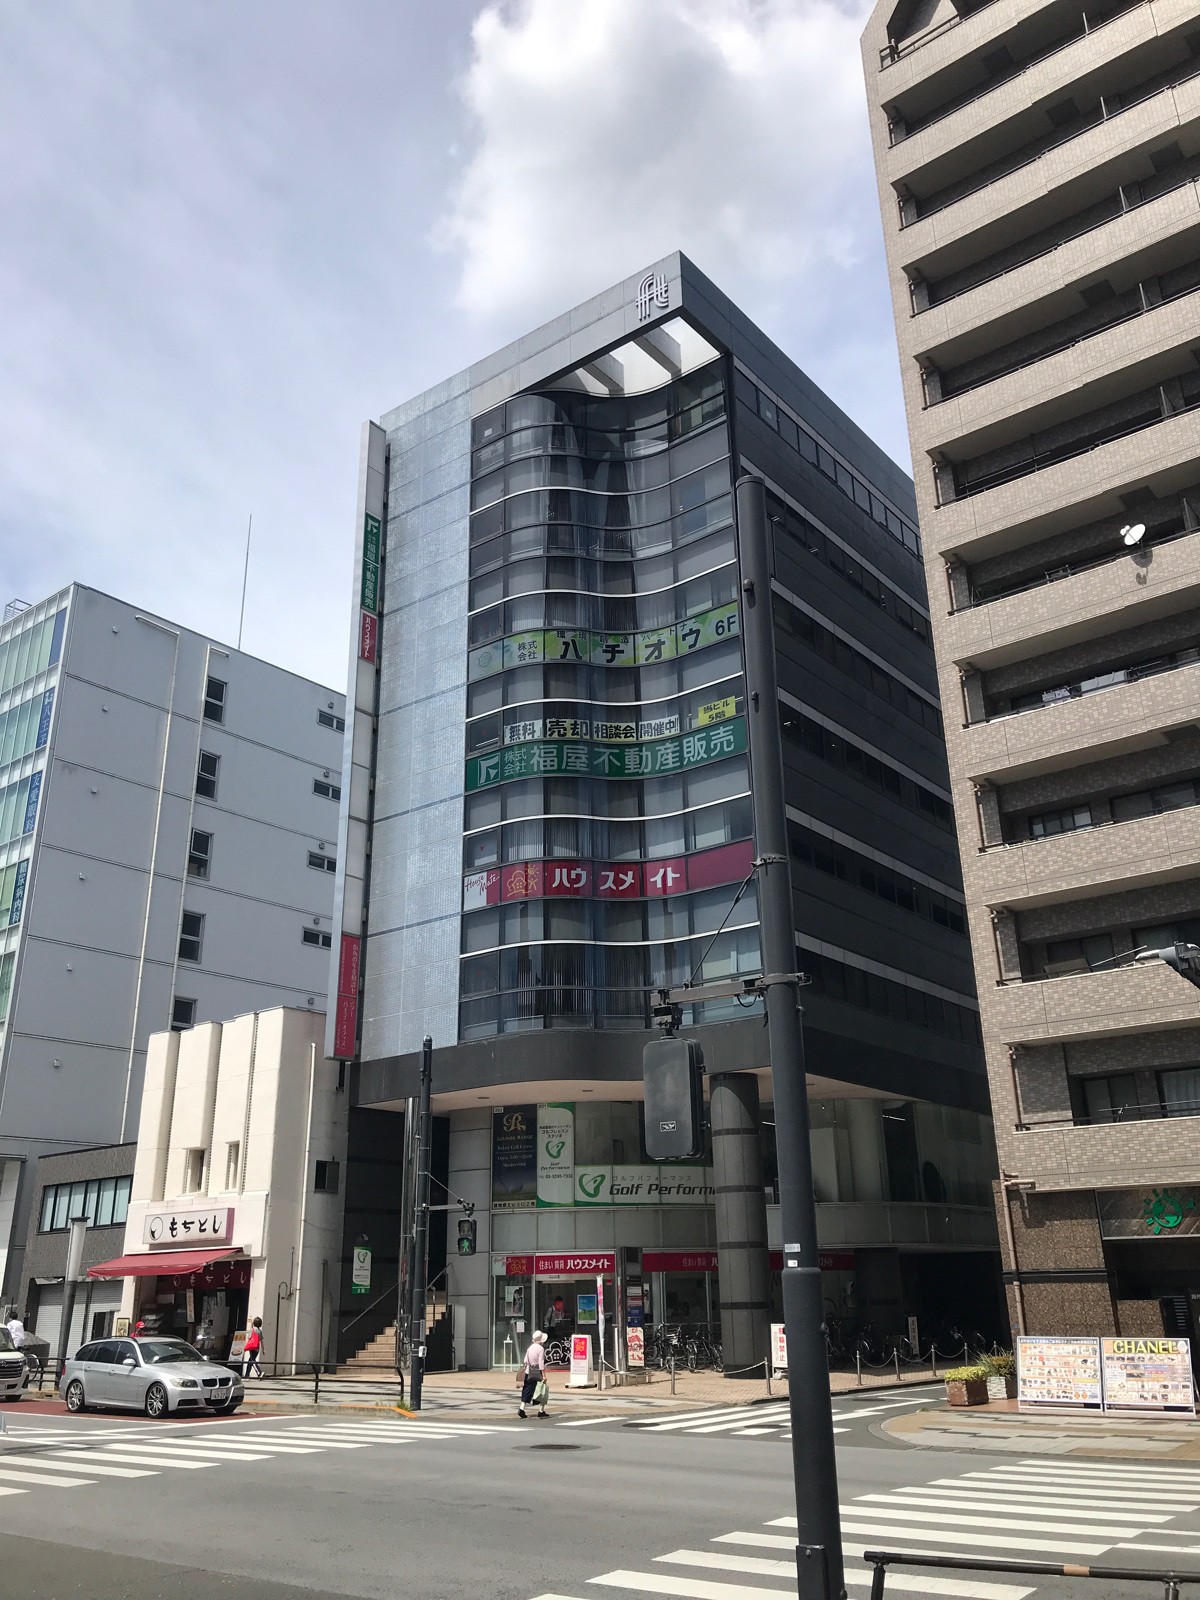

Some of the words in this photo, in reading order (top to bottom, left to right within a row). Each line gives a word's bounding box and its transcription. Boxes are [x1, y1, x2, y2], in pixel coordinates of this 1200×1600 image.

[715, 614, 736, 636] 6F
[547, 719, 590, 738] 売却
[594, 723, 636, 740] 相談会
[530, 724, 735, 774] 福屋不動産販売
[552, 866, 681, 891] ハウスメイト
[609, 1183, 643, 1196] Golf
[169, 1214, 223, 1238] もちとし
[566, 1258, 611, 1270] ハウスメイト
[1113, 1340, 1174, 1354] CHANEL
